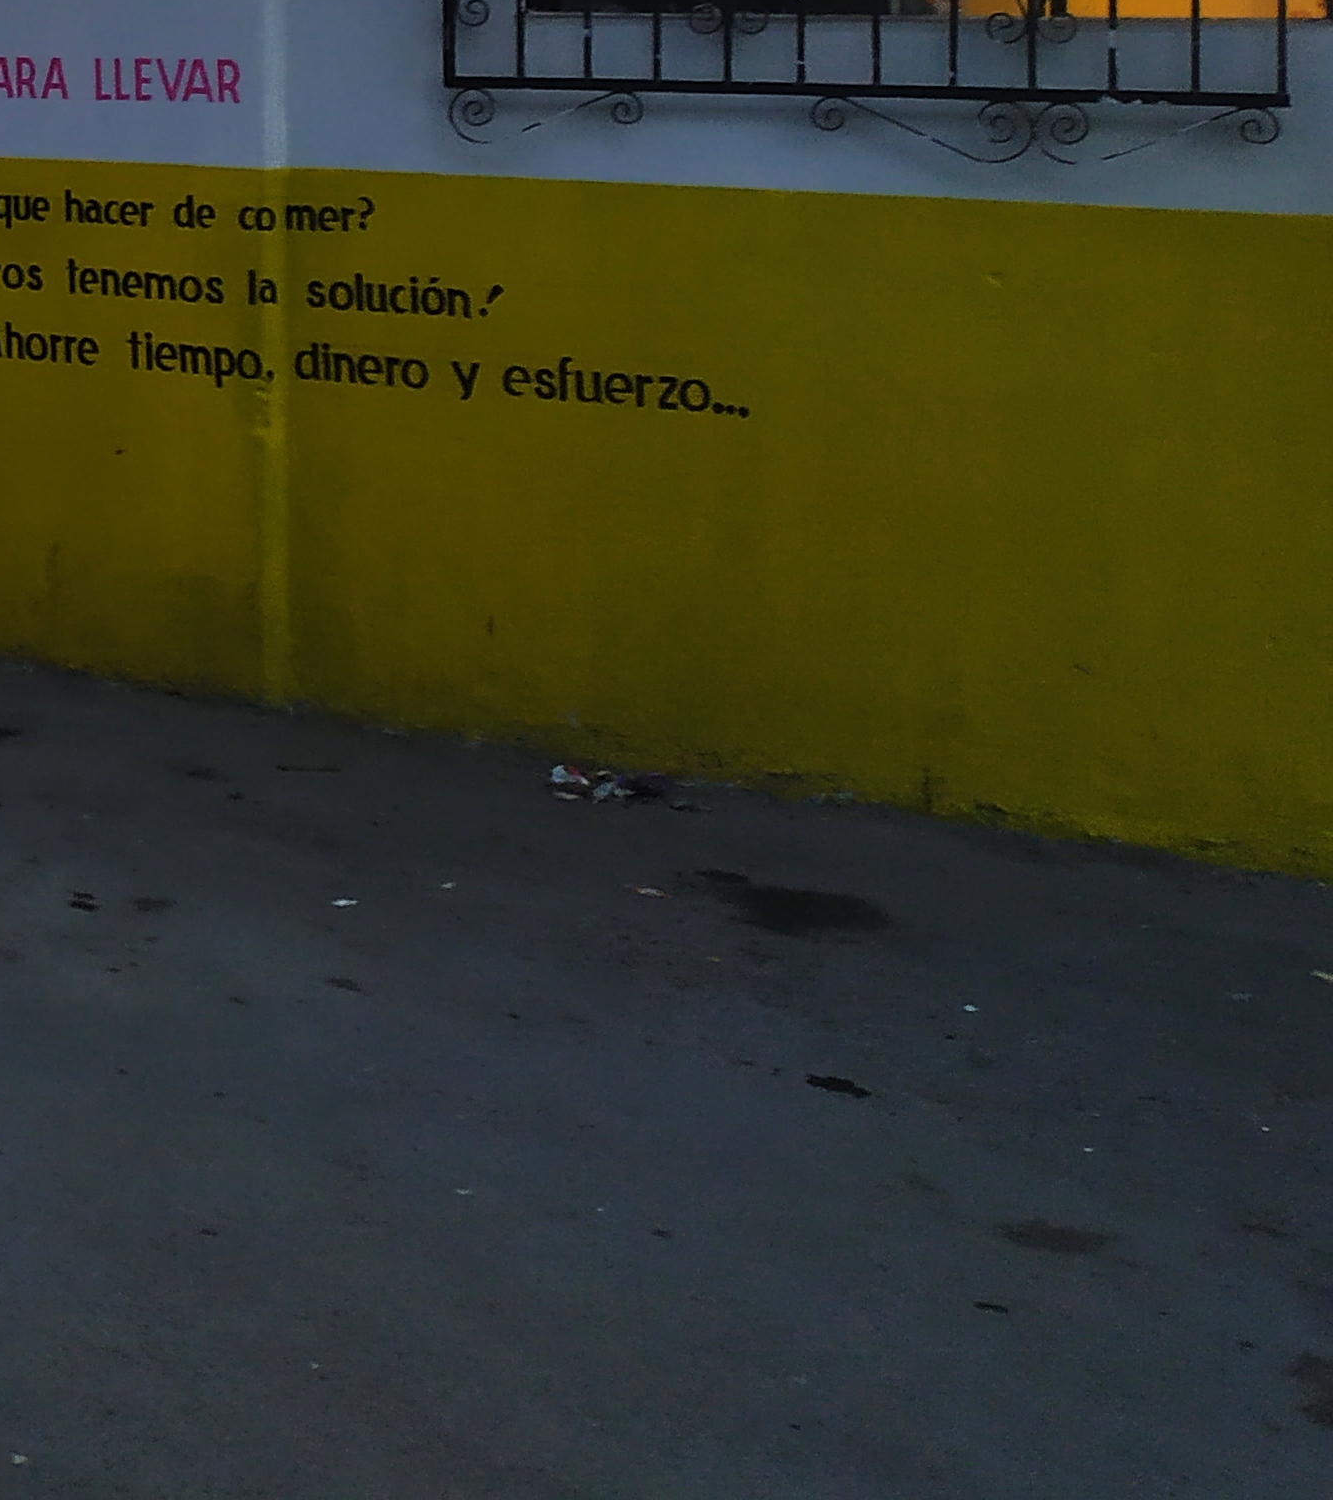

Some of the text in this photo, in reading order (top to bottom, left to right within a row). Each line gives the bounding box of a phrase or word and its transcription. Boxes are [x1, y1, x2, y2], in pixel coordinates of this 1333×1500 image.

[94, 57, 241, 103] LLEVAR
[64, 189, 155, 228] hacer
[173, 194, 216, 229] de
[66, 257, 225, 305] tenemos
[247, 268, 278, 306] la
[306, 272, 505, 319] solución!
[294, 342, 430, 390] dinero
[451, 360, 481, 401] y
[502, 356, 751, 419] esfuerzo...
